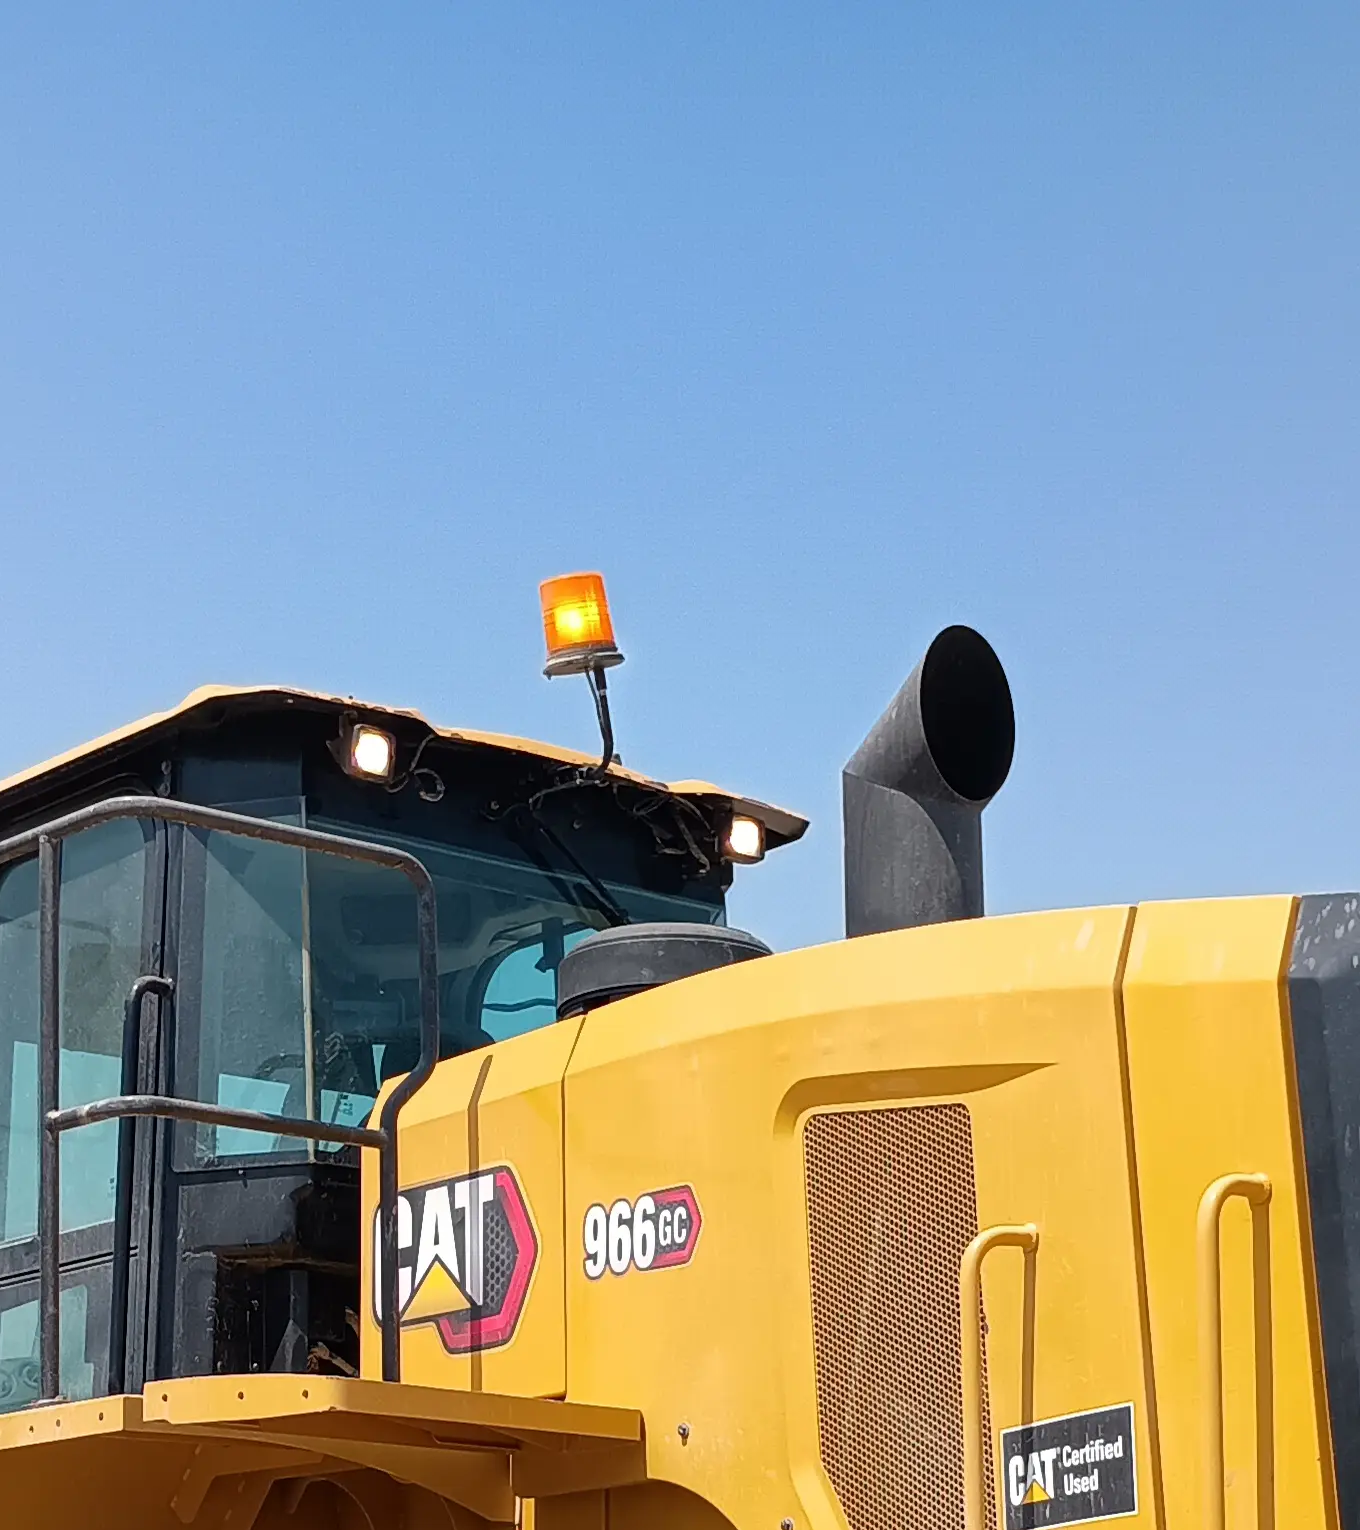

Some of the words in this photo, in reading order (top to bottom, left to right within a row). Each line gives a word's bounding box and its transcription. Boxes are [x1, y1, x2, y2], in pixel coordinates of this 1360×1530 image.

[374, 1173, 494, 1322] CAT
[1008, 1447, 1057, 1506] CAT
[1062, 1435, 1124, 1467] Certified
[1063, 1468, 1099, 1496] Used
